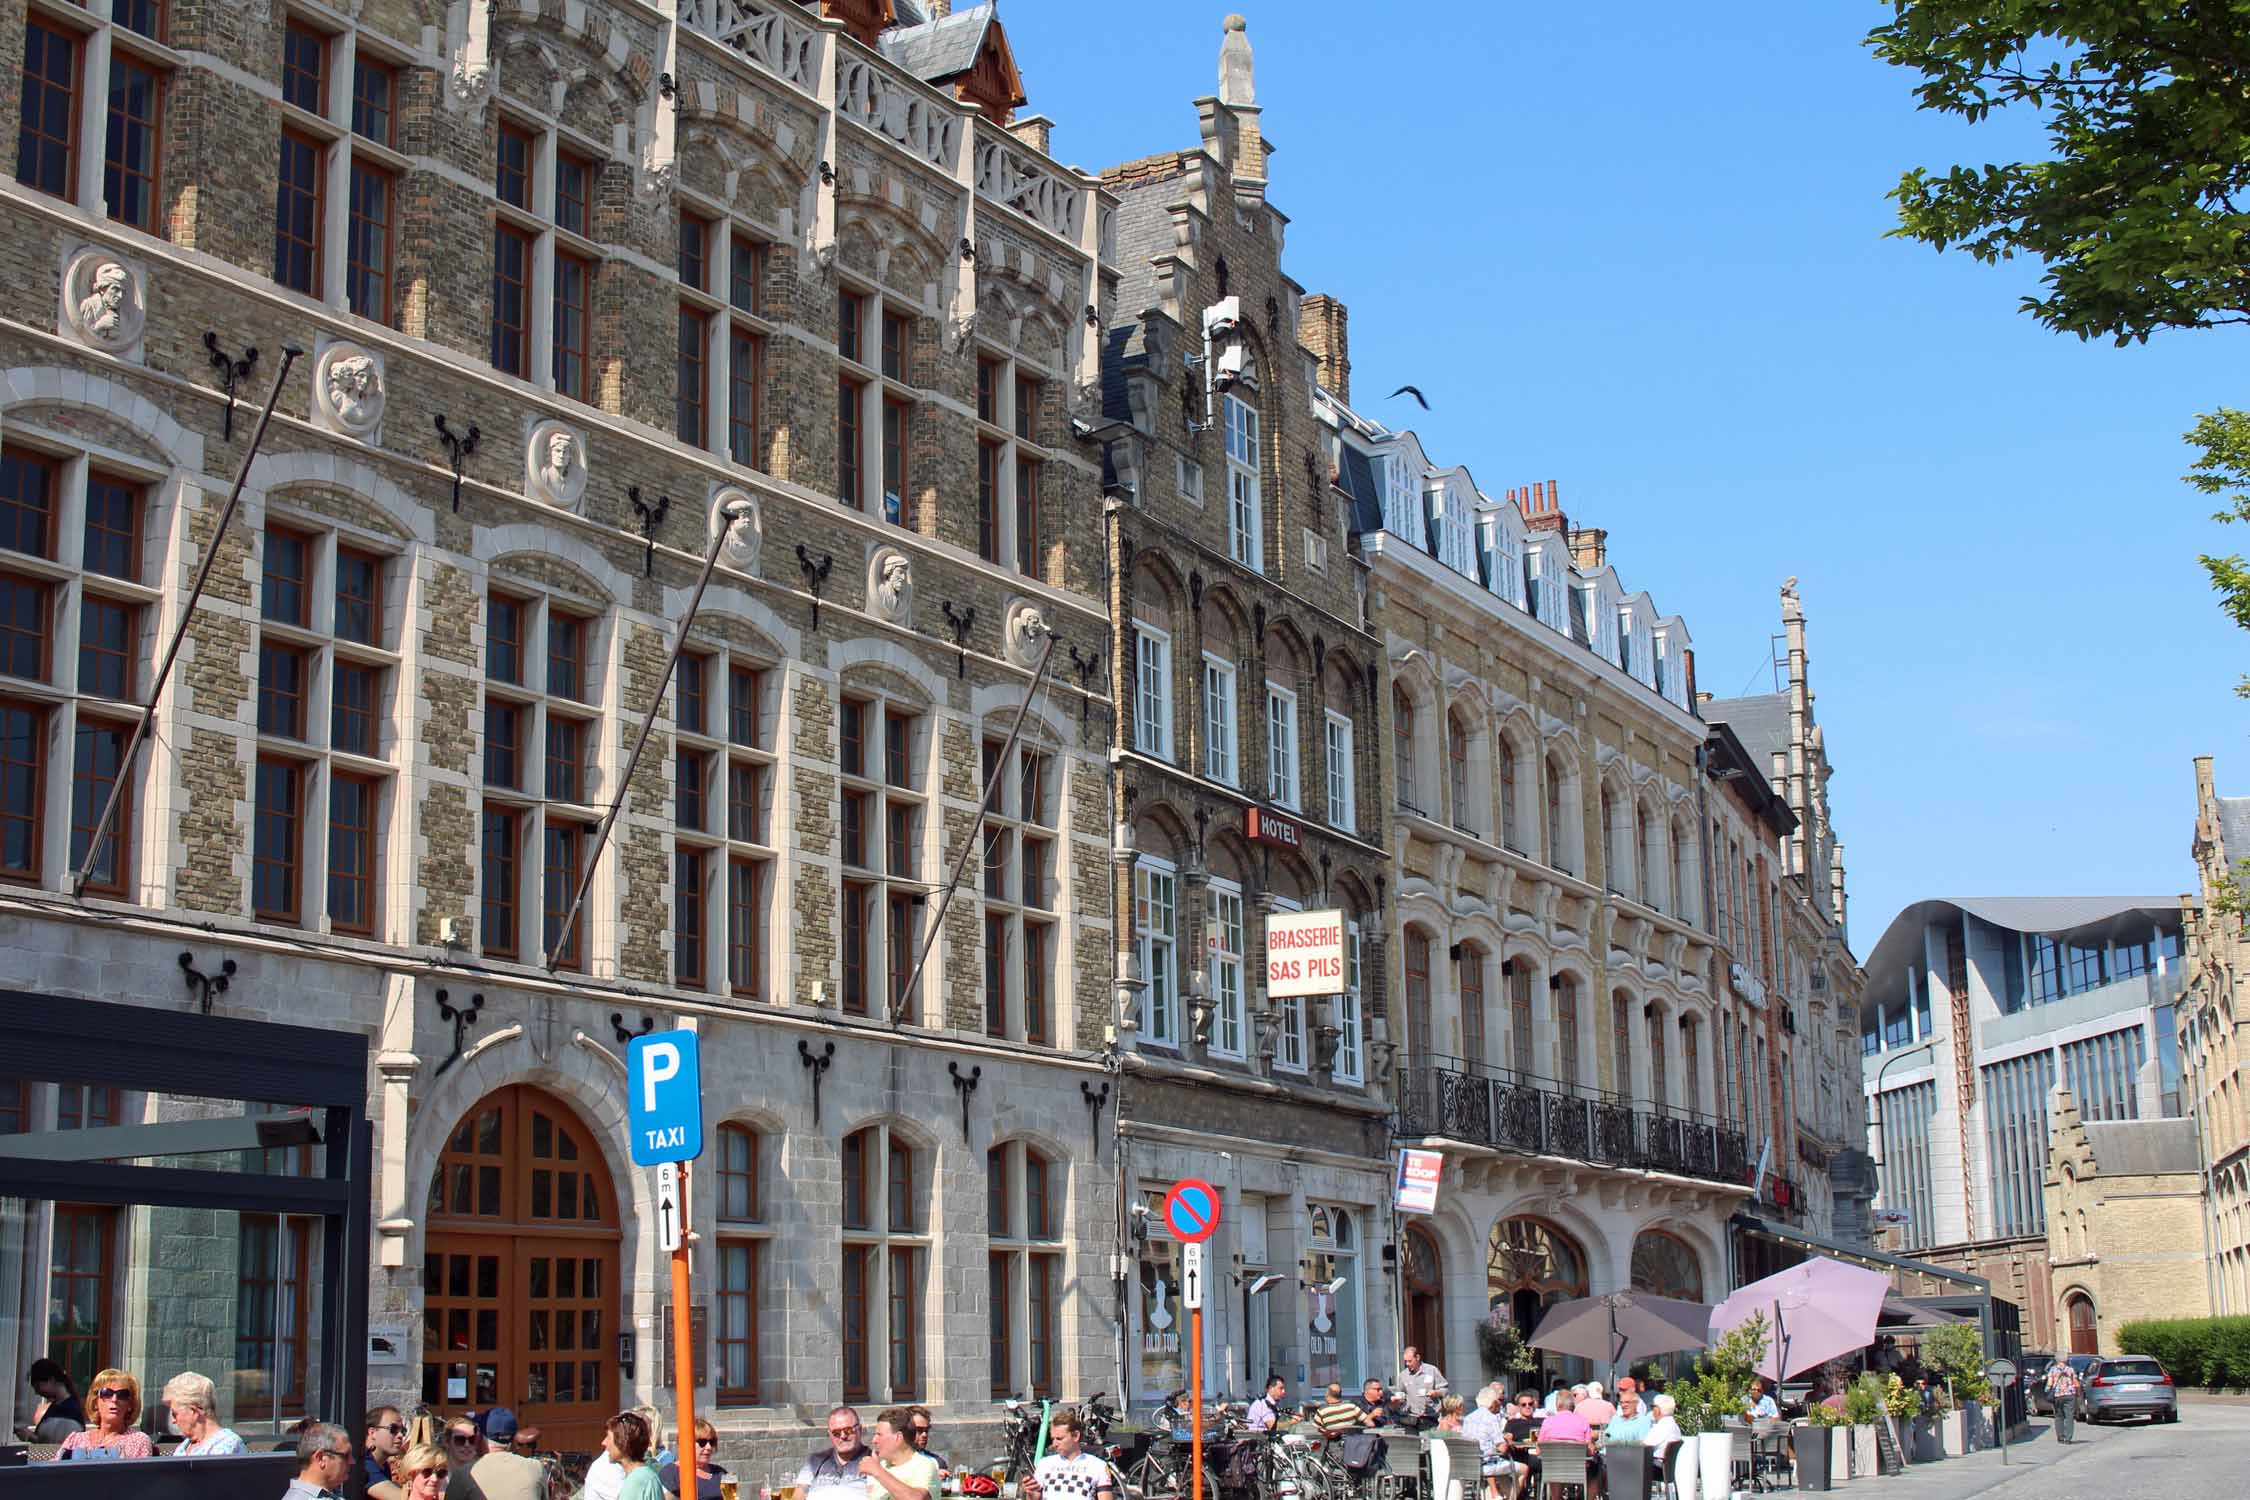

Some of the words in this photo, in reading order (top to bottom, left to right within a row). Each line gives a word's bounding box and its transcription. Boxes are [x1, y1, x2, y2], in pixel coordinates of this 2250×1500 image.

[1261, 815, 1298, 846] HOTEL
[1269, 926, 1340, 950] BRASSERIE
[1270, 960, 1301, 981] SAS
[1308, 957, 1341, 979] PILS
[642, 1042, 680, 1112] P
[645, 1126, 685, 1150] TAXI
[662, 1168, 669, 1181] 6
[661, 1183, 671, 1193] m
[1188, 1247, 1197, 1257] 6
[1146, 1333, 1160, 1352] OLD
[1163, 1333, 1179, 1352] TOM
[1310, 1336, 1322, 1354] OLD
[1324, 1336, 1337, 1354] TOM
